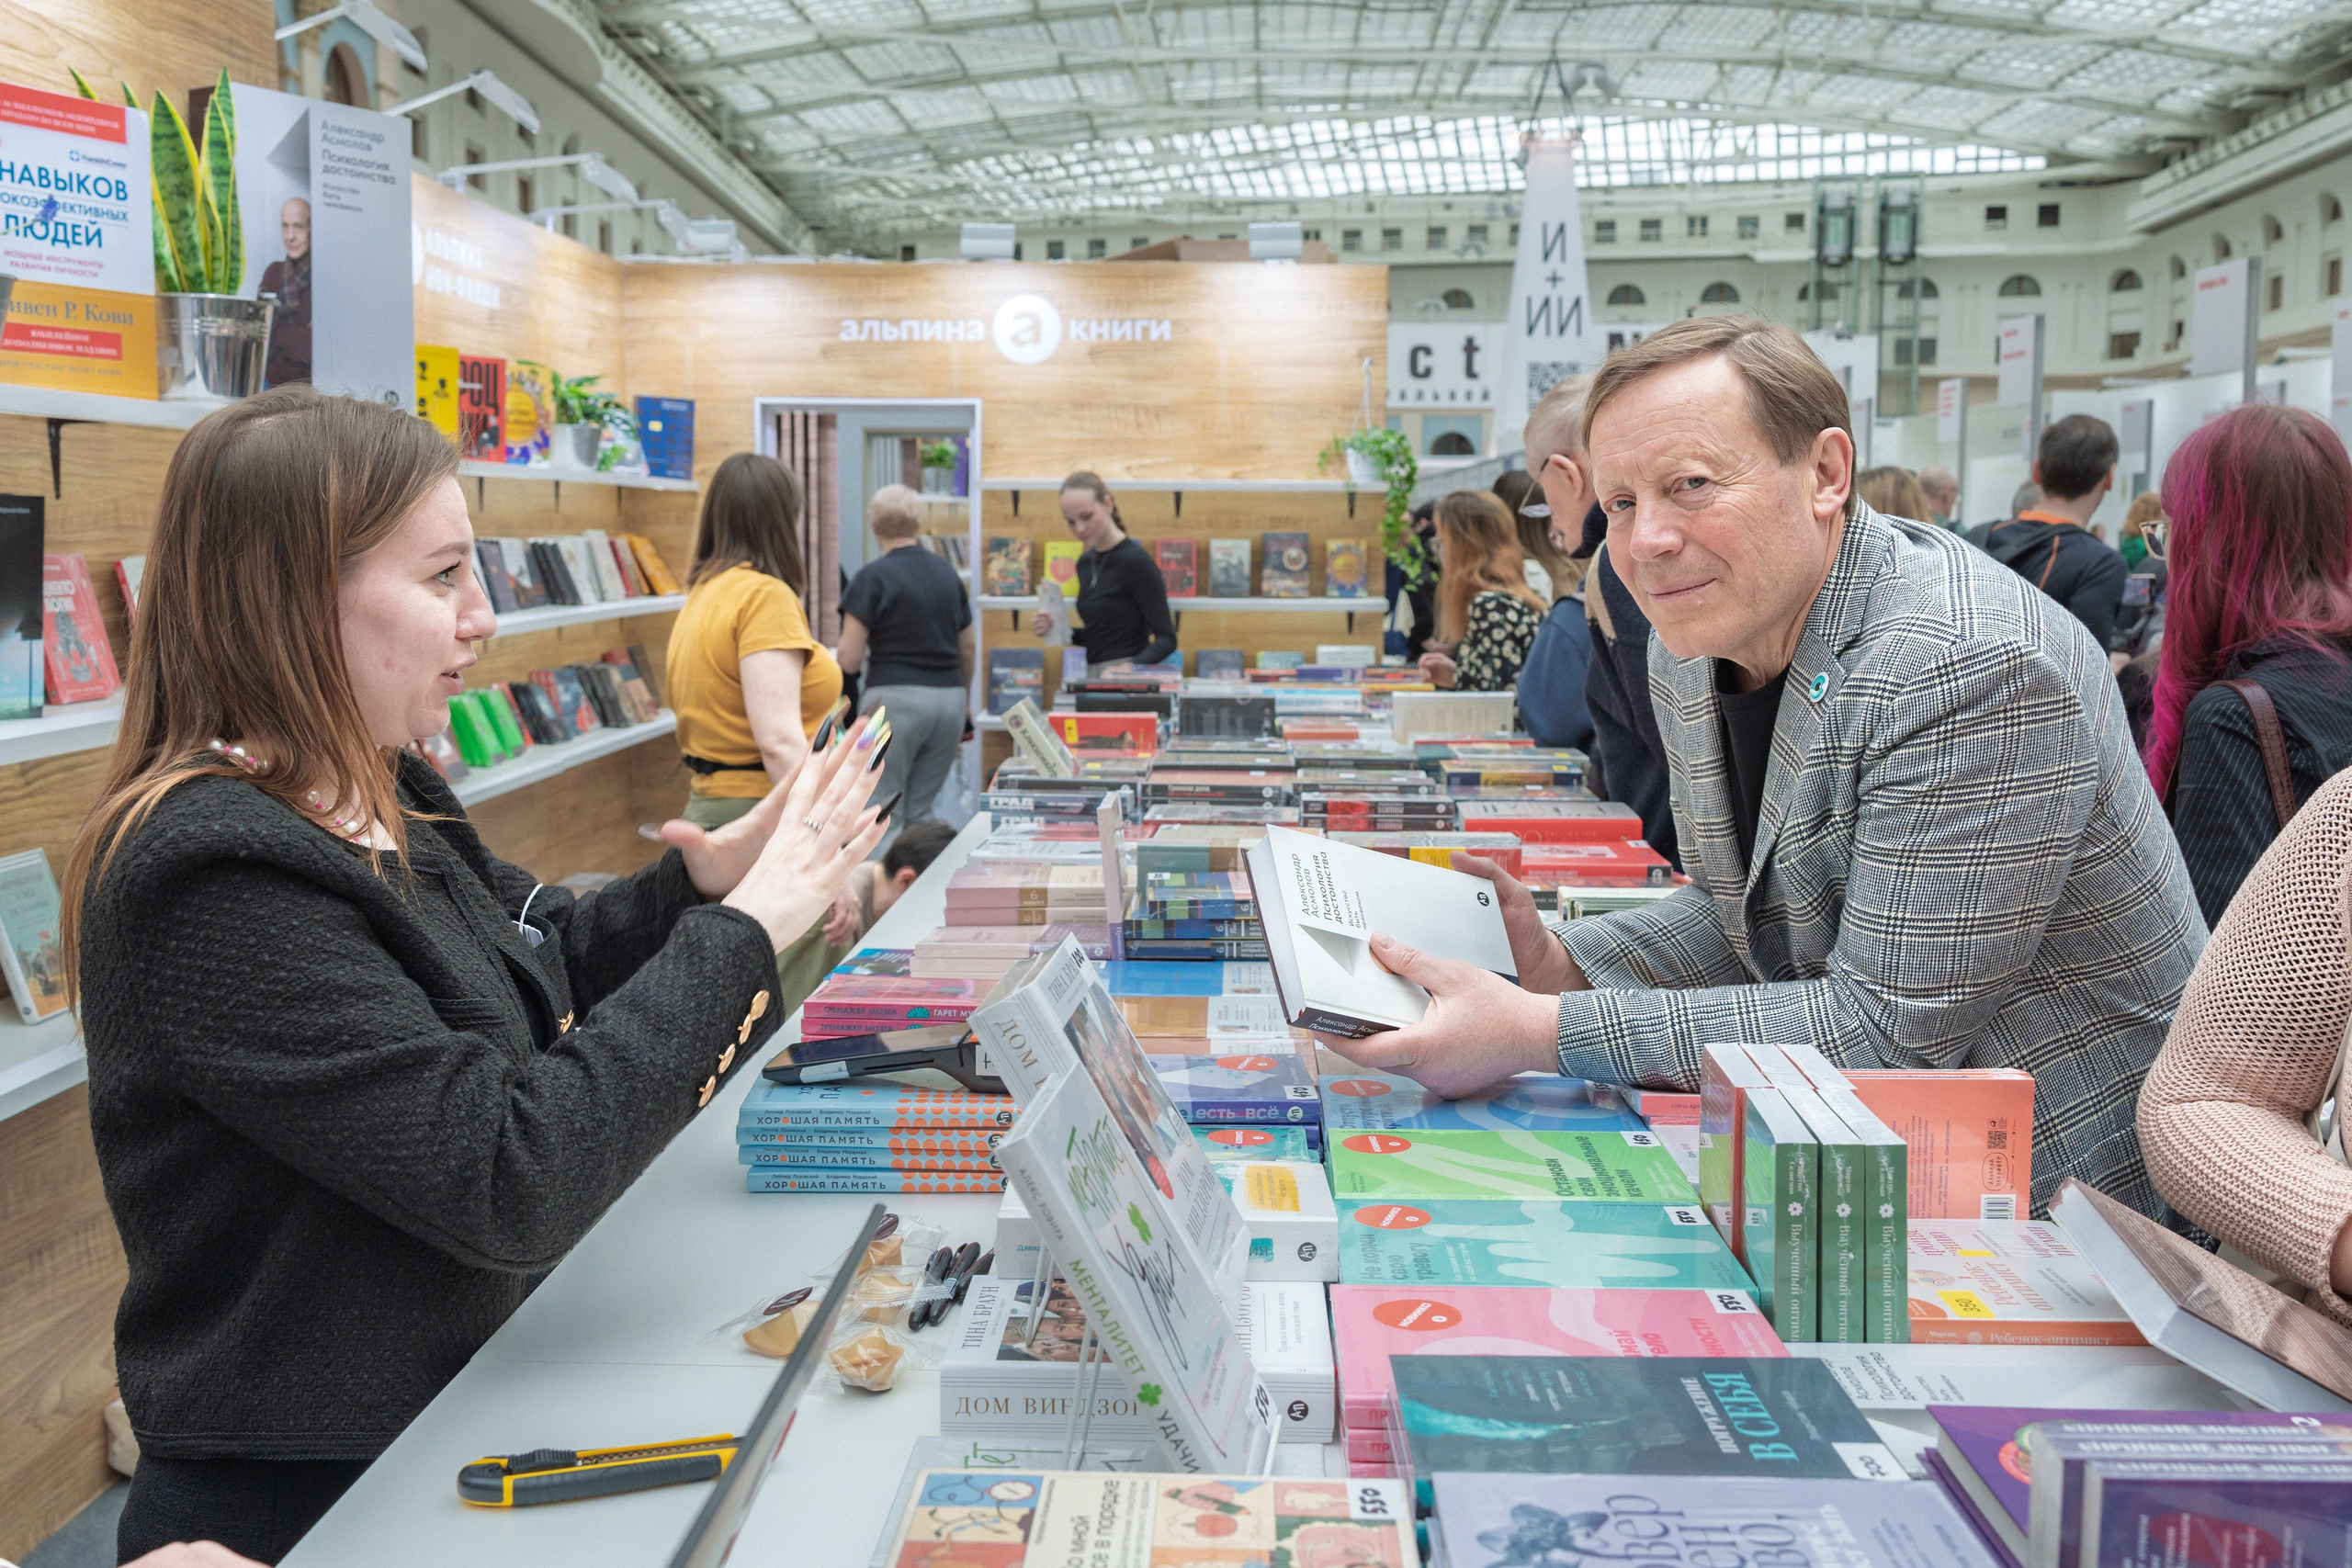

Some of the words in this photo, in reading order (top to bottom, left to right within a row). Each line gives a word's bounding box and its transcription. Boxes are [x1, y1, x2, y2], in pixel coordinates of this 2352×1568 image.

[322, 120, 384, 145] Александр
[322, 132, 373, 152] Асмолов
[322, 149, 390, 172] Психология
[0, 158, 129, 201] НАВЫКОВ
[5, 213, 103, 249] ЛЮДЕЙ
[64, 300, 79, 320] Р.
[85, 302, 134, 326] Кови
[840, 318, 986, 342] альпина
[1068, 318, 1172, 342] книги
[1030, 890, 1038, 900] 6
[1292, 852, 1310, 917] Александр
[1303, 868, 1319, 919] Асмолов
[1314, 854, 1332, 921] Психология
[1320, 851, 1343, 925] достоинства
[1341, 890, 1355, 927] Искусство
[1353, 910, 1363, 929] быть
[1354, 891, 1368, 931] человеком
[1047, 974, 1069, 1004] ТИНА
[824, 1006, 866, 1014] ТРЕНАЖЕР
[868, 1007, 897, 1015] МОЗГА
[933, 1009, 957, 1017] ГАРЕТ
[1315, 1016, 1358, 1031] Александр
[820, 1023, 863, 1032] ТРЕНАЖЕР
[993, 1018, 1039, 1069] ДОМ
[825, 1116, 880, 1125] ПАМЯТЬ
[1195, 1107, 1236, 1120] есть
[819, 1135, 873, 1145] ПАМЯТЬ
[821, 1156, 876, 1165] ПАМЯТЬ
[1575, 1135, 1622, 1199] эмоциональные
[831, 1180, 886, 1190] ПАМЯТЬ
[1018, 1168, 1041, 1201] АЛЕКС
[1177, 1156, 1195, 1197] ДОМ
[1544, 1157, 1576, 1198] Останови
[1575, 1176, 1599, 1198] свои
[1614, 1168, 1645, 1199] качели
[1185, 1165, 1216, 1247] ВИНДЗОРОВ
[1675, 1211, 1698, 1224] 550
[1359, 1233, 1385, 1265] корми
[1409, 1242, 1441, 1280] тревогу
[1789, 1224, 1805, 1296] Выученный
[1837, 1224, 1851, 1296] Выученный
[1881, 1224, 1896, 1296] Выученный
[1361, 1266, 1384, 1280] Не
[1387, 1254, 1409, 1280] свою
[1962, 1261, 2021, 1306] Ребенок-
[1985, 1261, 2054, 1312] оптимист
[973, 1286, 1000, 1316] БРАУН
[1716, 1294, 1747, 1312] 550
[1955, 1297, 1981, 1314] 350
[962, 1320, 989, 1349] ТИНА
[1989, 1332, 2111, 1346] Ребенок-оптимист
[1069, 1258, 1147, 1378] МЕНТАЛИТЕТ
[1156, 1409, 1202, 1473] УДАЧИ
[1855, 1355, 1898, 1401] Психология
[1839, 1365, 1873, 1401] Асмолов
[955, 1396, 1011, 1417] ДОМ
[1702, 1371, 1781, 1438] СЕБЯ
[1747, 1441, 1800, 1462] В
[1096, 1480, 1120, 1537] порядке
[1361, 1486, 1391, 1516] 550
[1069, 1515, 1091, 1553] мной
